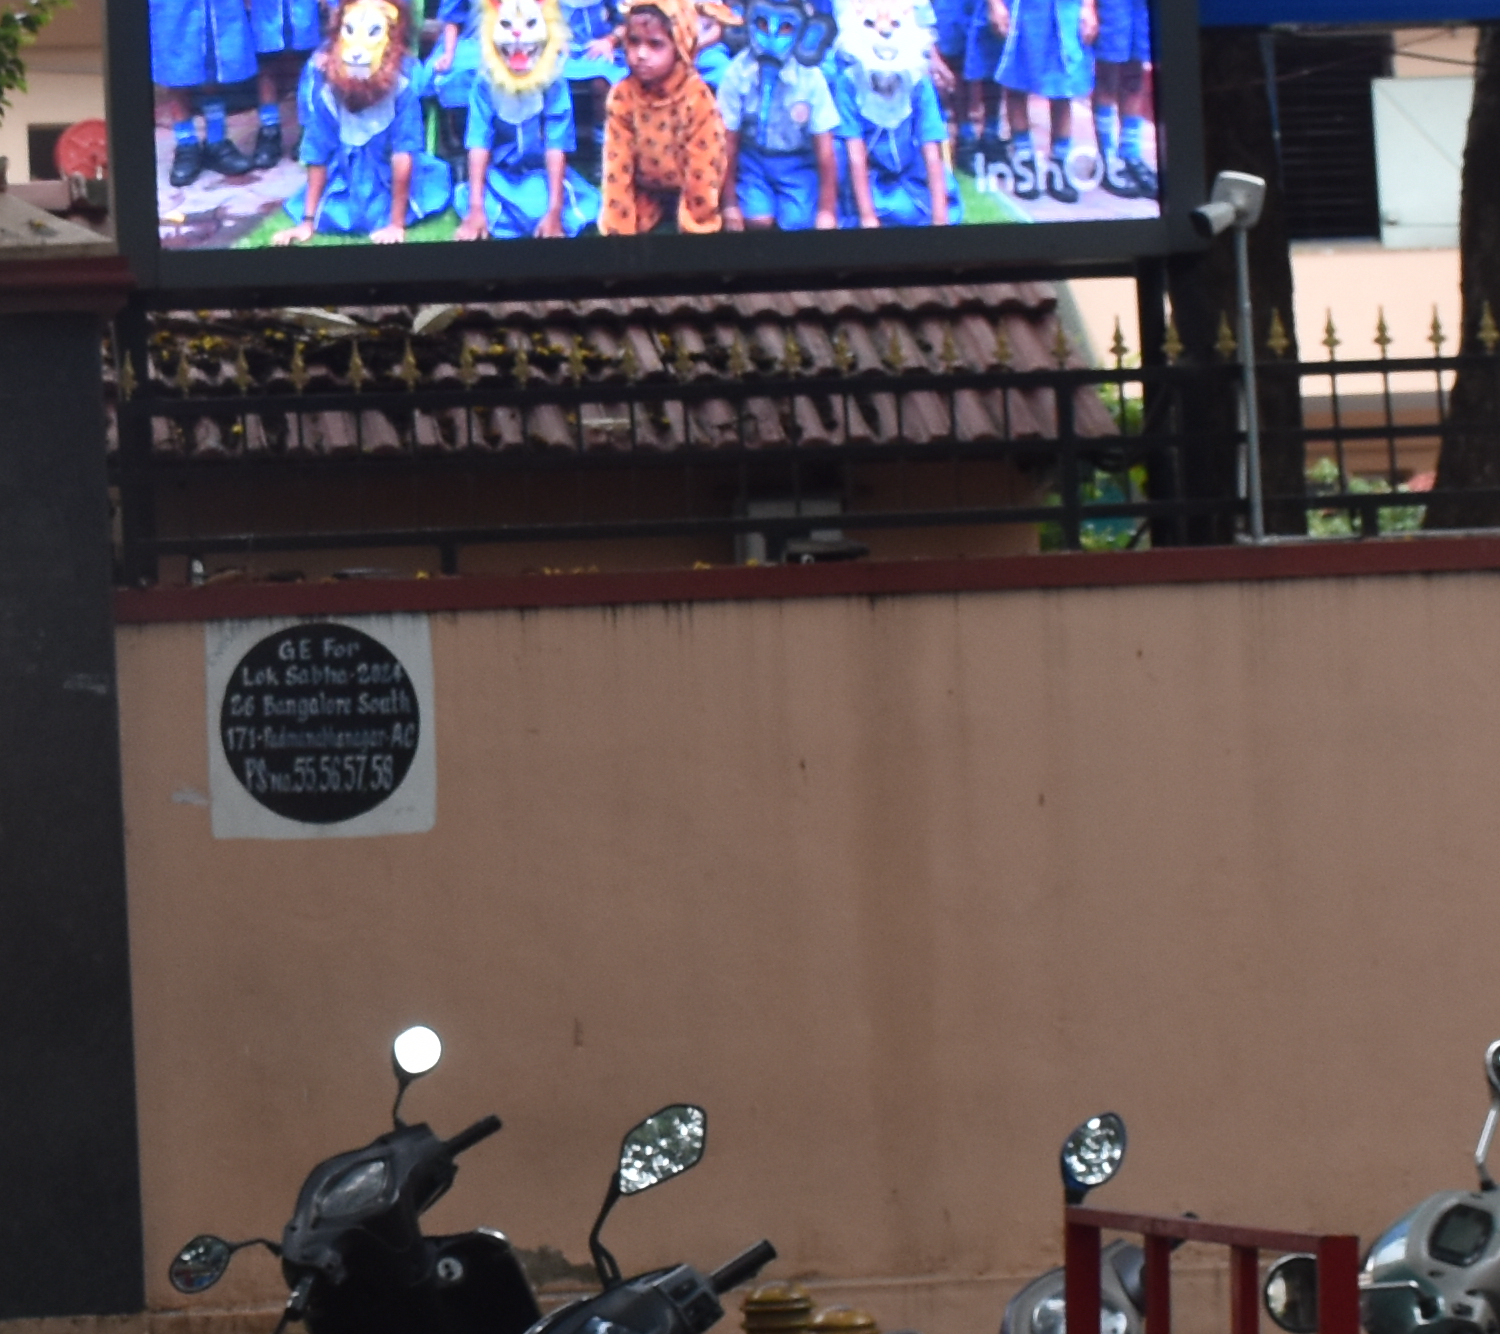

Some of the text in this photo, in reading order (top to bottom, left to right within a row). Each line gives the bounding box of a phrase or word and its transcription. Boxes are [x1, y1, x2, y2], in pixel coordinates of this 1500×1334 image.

[321, 637, 361, 659] For
[242, 666, 280, 687] Lok
[356, 688, 412, 715] South
